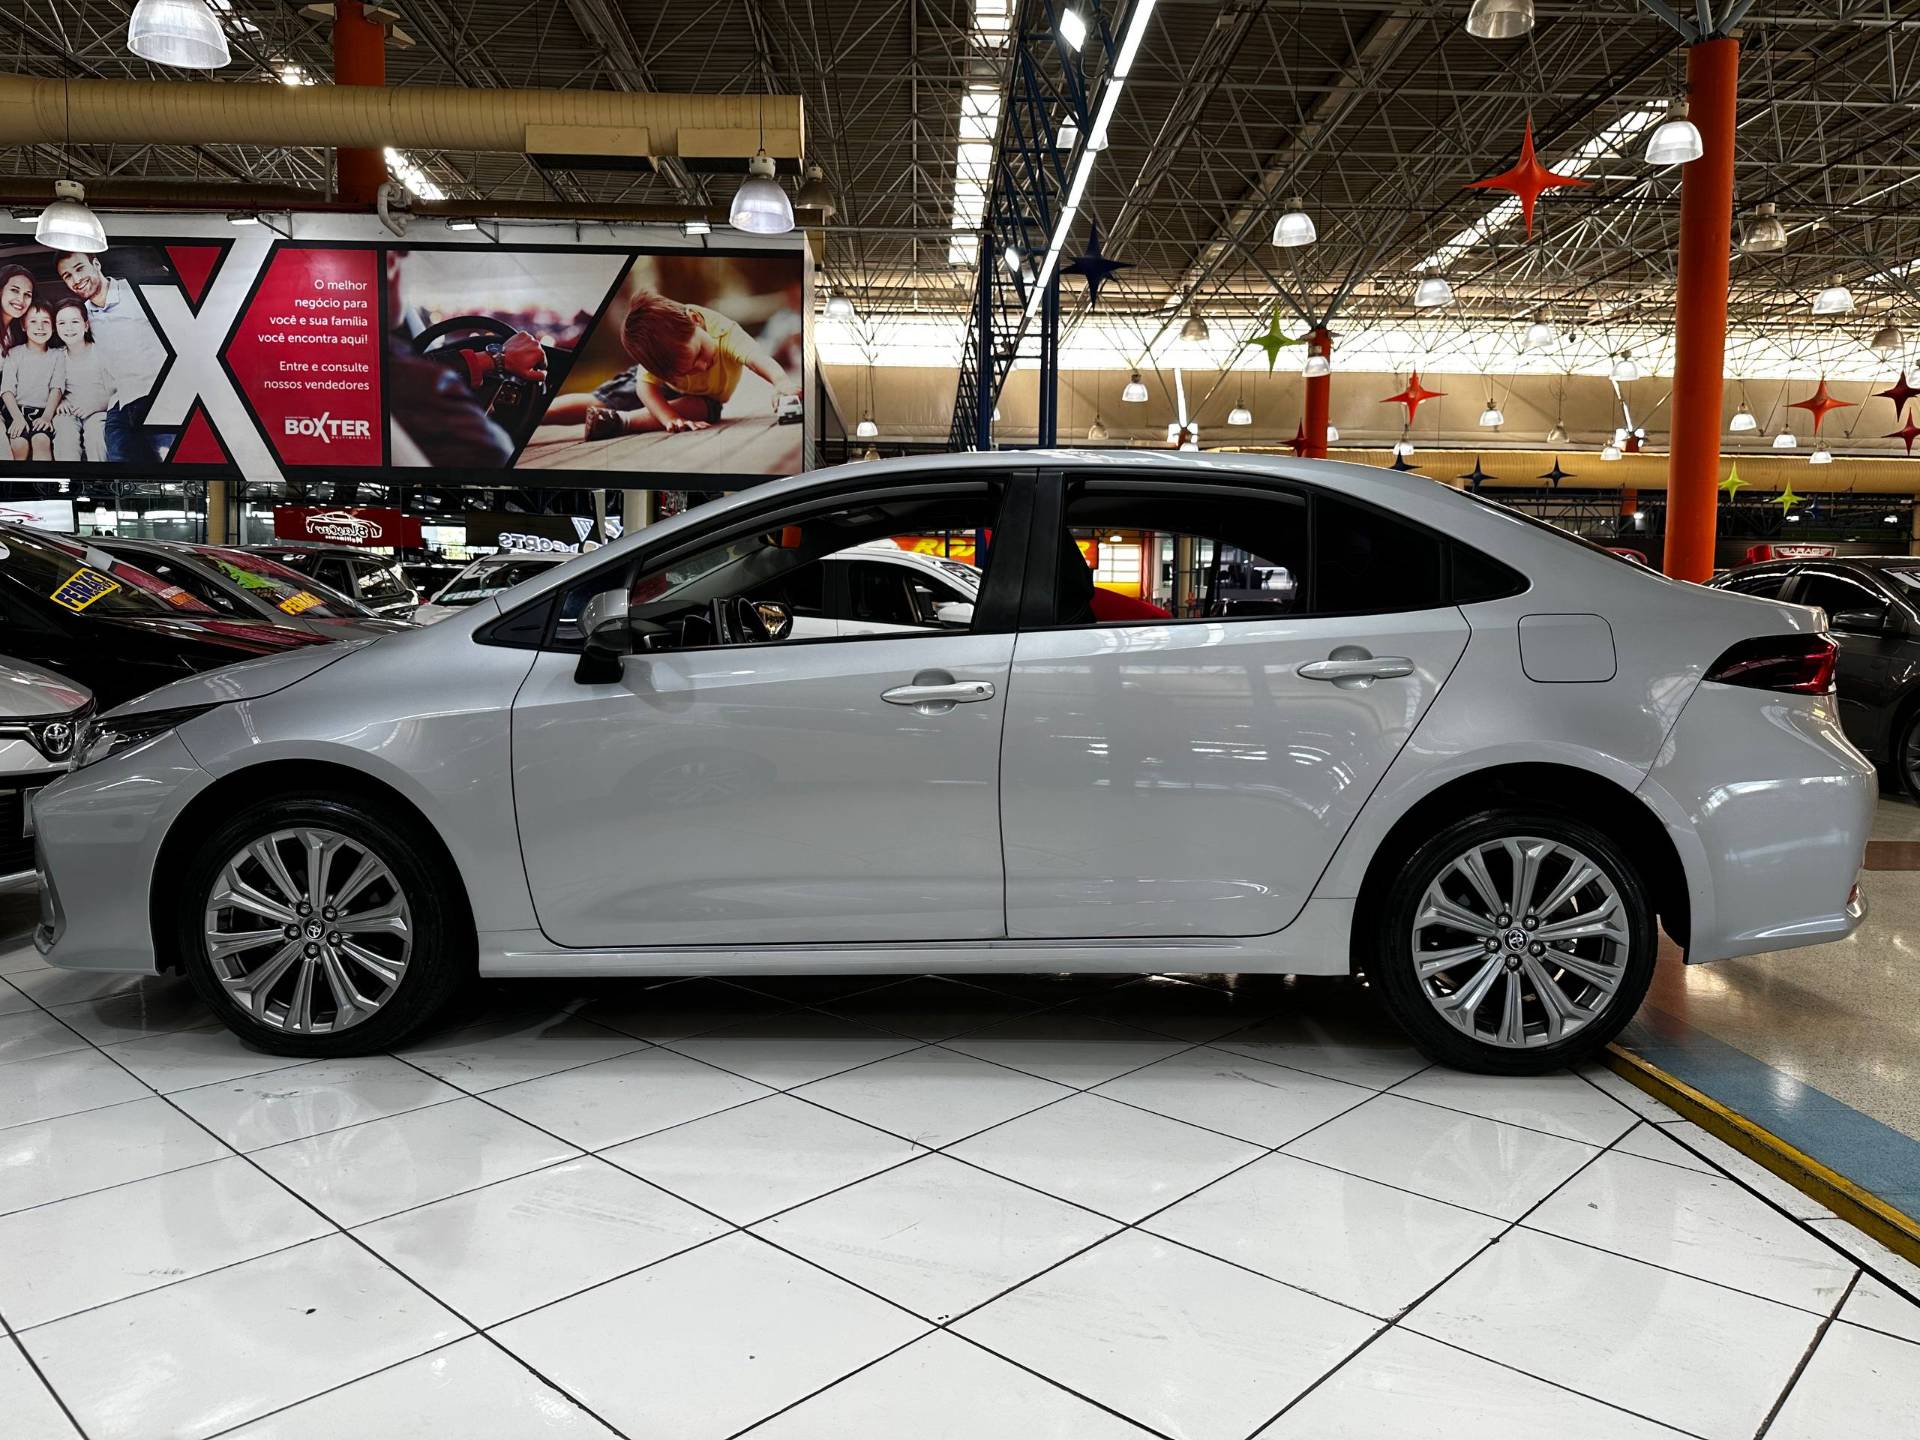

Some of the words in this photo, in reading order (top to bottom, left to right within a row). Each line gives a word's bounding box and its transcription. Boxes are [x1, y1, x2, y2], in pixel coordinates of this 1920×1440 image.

[314, 279, 325, 290] O
[327, 280, 368, 291] melhor
[295, 298, 340, 310] negócio
[343, 300, 368, 310] para
[269, 315, 297, 325] você
[299, 317, 307, 325] e
[309, 317, 328, 326] sua
[331, 316, 368, 327] família
[258, 333, 285, 343] você
[287, 333, 338, 344] encontra
[340, 334, 368, 346] aqui!
[280, 361, 309, 371] Entre
[311, 363, 319, 371] e
[321, 362, 369, 372] consulte
[264, 380, 302, 389] nossos
[304, 380, 370, 391] vendedores
[285, 412, 371, 443] BOXTER
